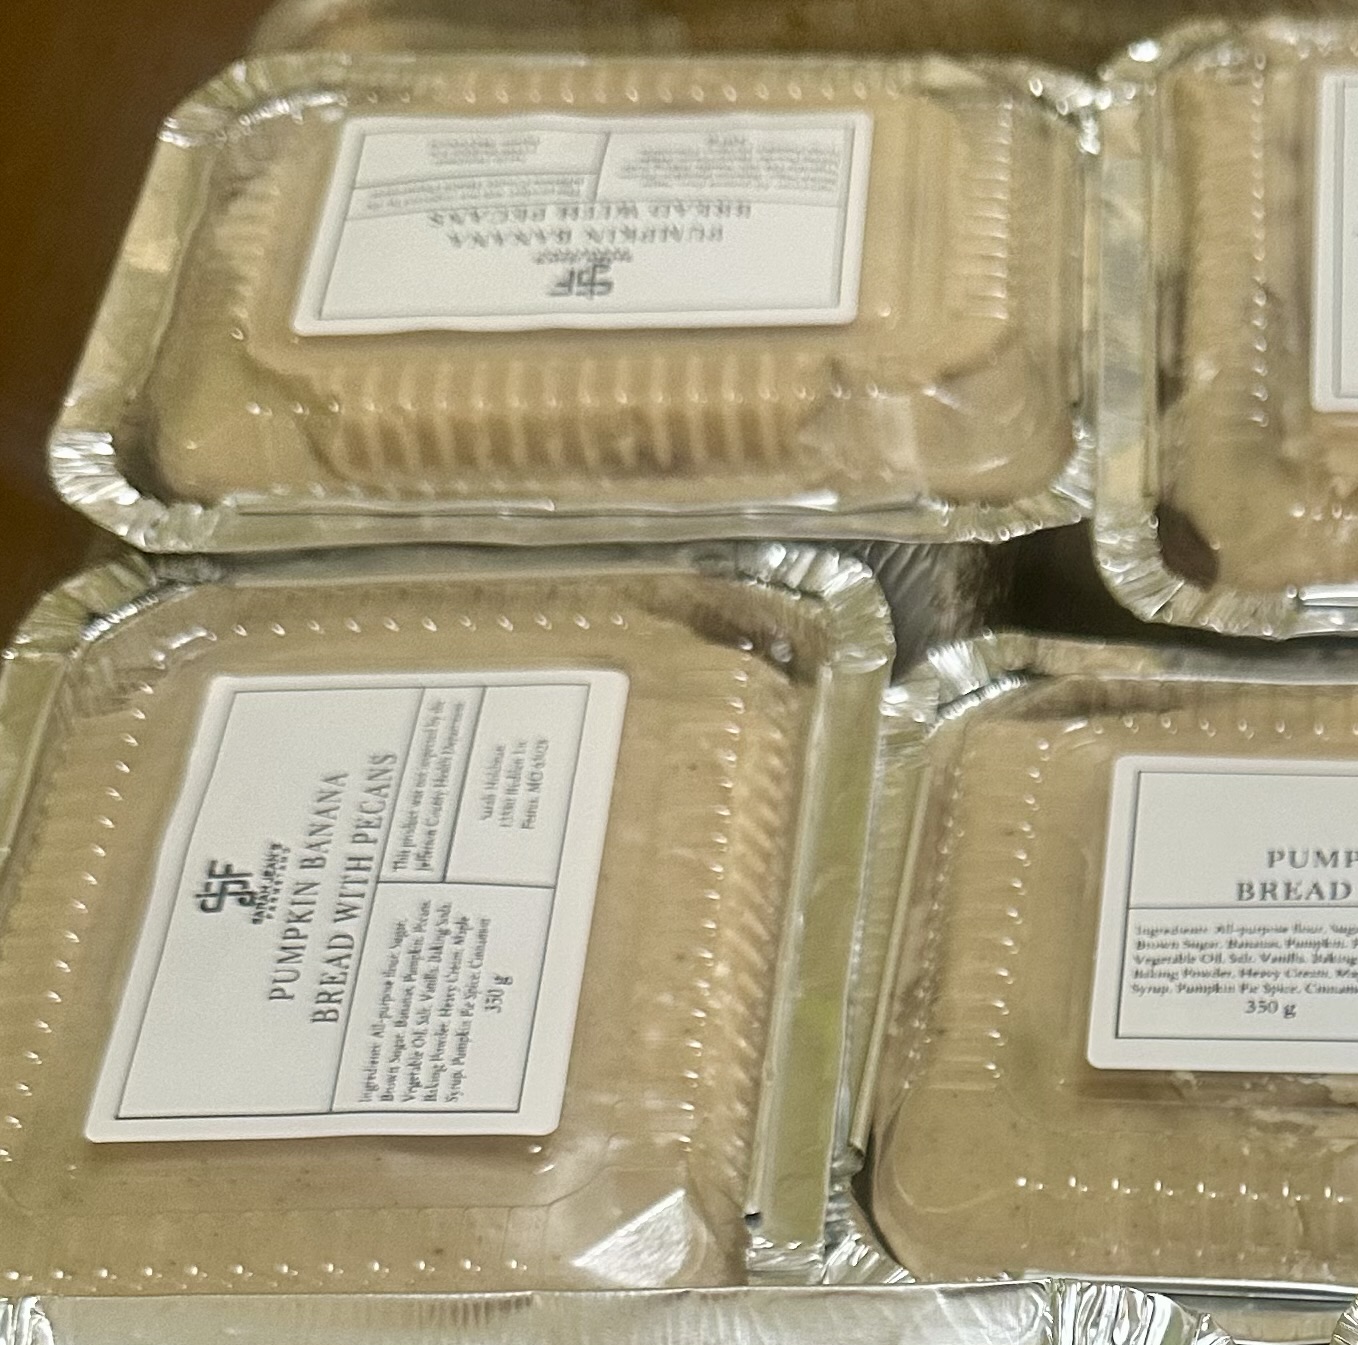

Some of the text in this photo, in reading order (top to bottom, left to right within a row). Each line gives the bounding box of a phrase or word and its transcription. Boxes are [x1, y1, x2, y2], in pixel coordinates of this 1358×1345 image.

[266, 880, 321, 1000] PUMPKIN
[298, 772, 349, 869] BANANA
[308, 752, 398, 1023] BREAD WITH PECANS
[1235, 879, 1353, 904] BREAD
[1244, 998, 1297, 1019] 350 g
